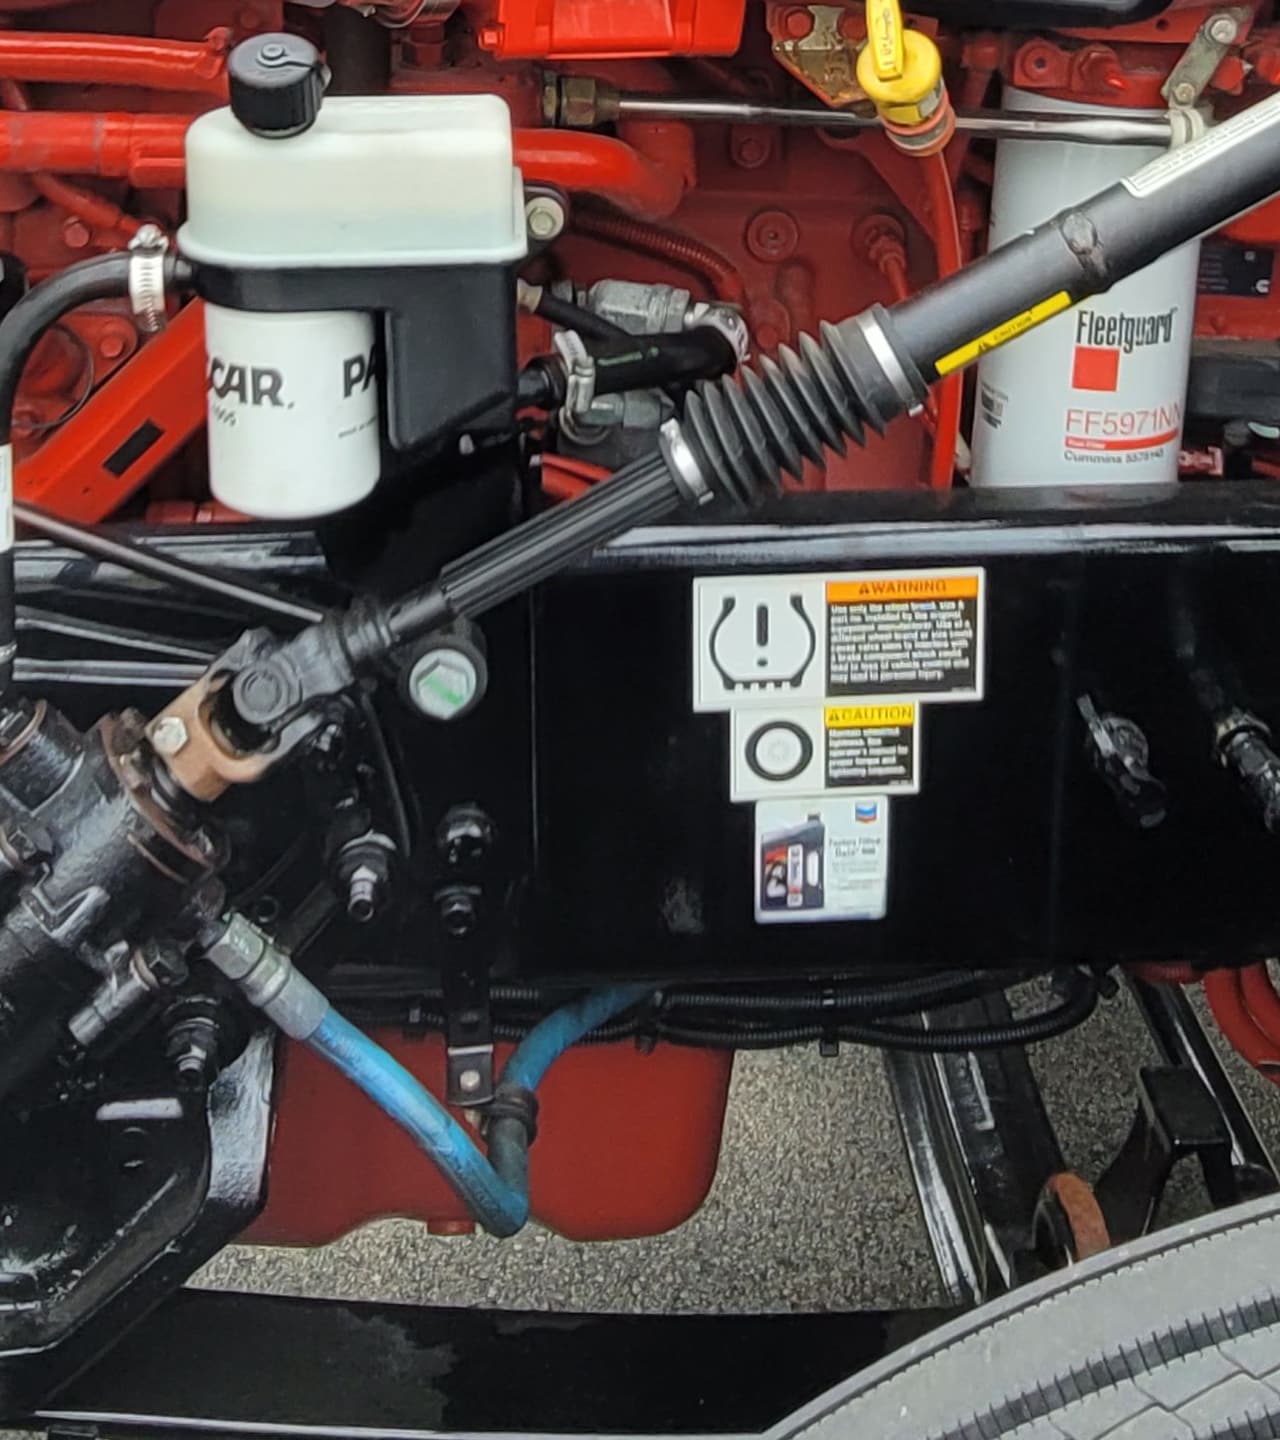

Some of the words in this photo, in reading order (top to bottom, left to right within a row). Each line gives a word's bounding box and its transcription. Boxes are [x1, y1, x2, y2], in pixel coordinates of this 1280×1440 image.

[1076, 310, 1174, 354] Fleetguard
[1064, 449, 1122, 463] Cummins
[872, 579, 947, 595] WARNING
[842, 706, 912, 721] CAUTION
